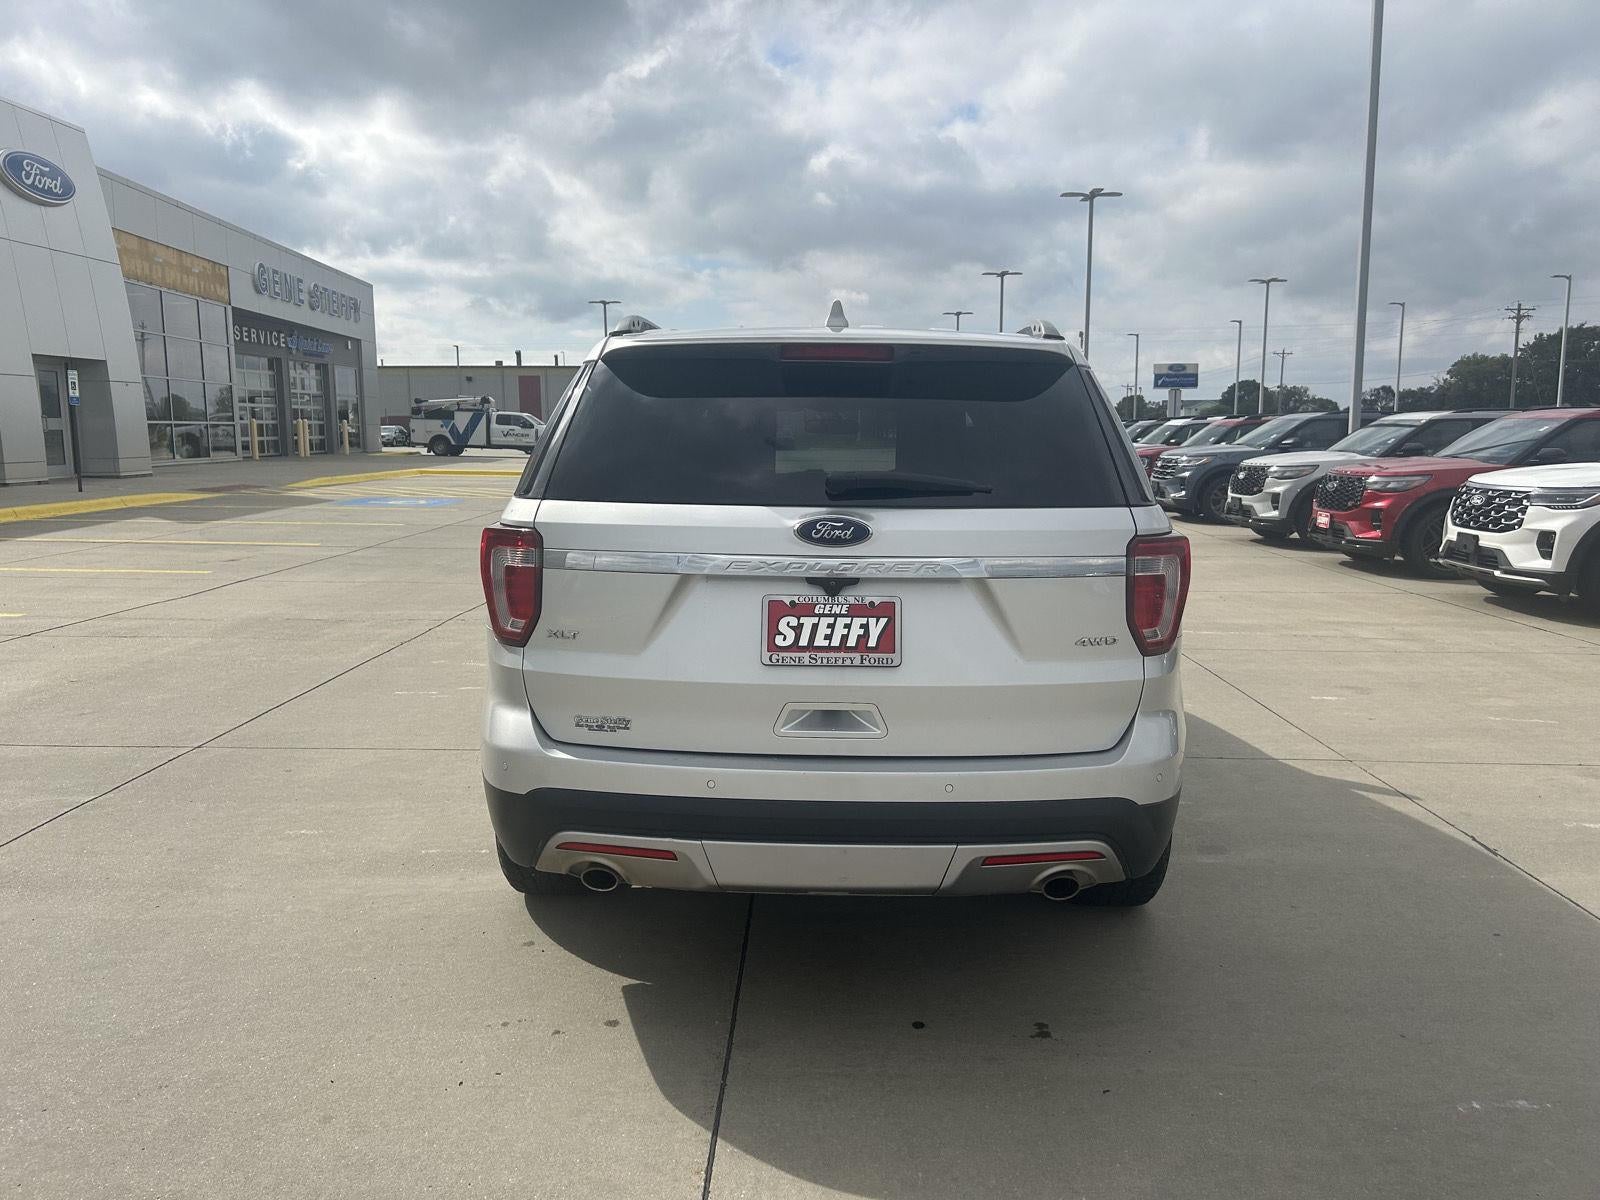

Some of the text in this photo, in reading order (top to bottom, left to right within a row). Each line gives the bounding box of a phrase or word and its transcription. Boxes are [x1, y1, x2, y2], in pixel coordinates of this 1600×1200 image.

[21, 159, 63, 194] Ford
[254, 260, 361, 323] GENE STEFFY
[233, 324, 286, 347] SERVICE
[811, 521, 854, 540] Ford
[724, 560, 942, 574] EXPLORER
[853, 596, 867, 604] NE
[814, 604, 850, 614] GENE
[547, 629, 579, 639] XLT
[774, 615, 889, 648] STEFFY
[1074, 636, 1119, 646] 4WD
